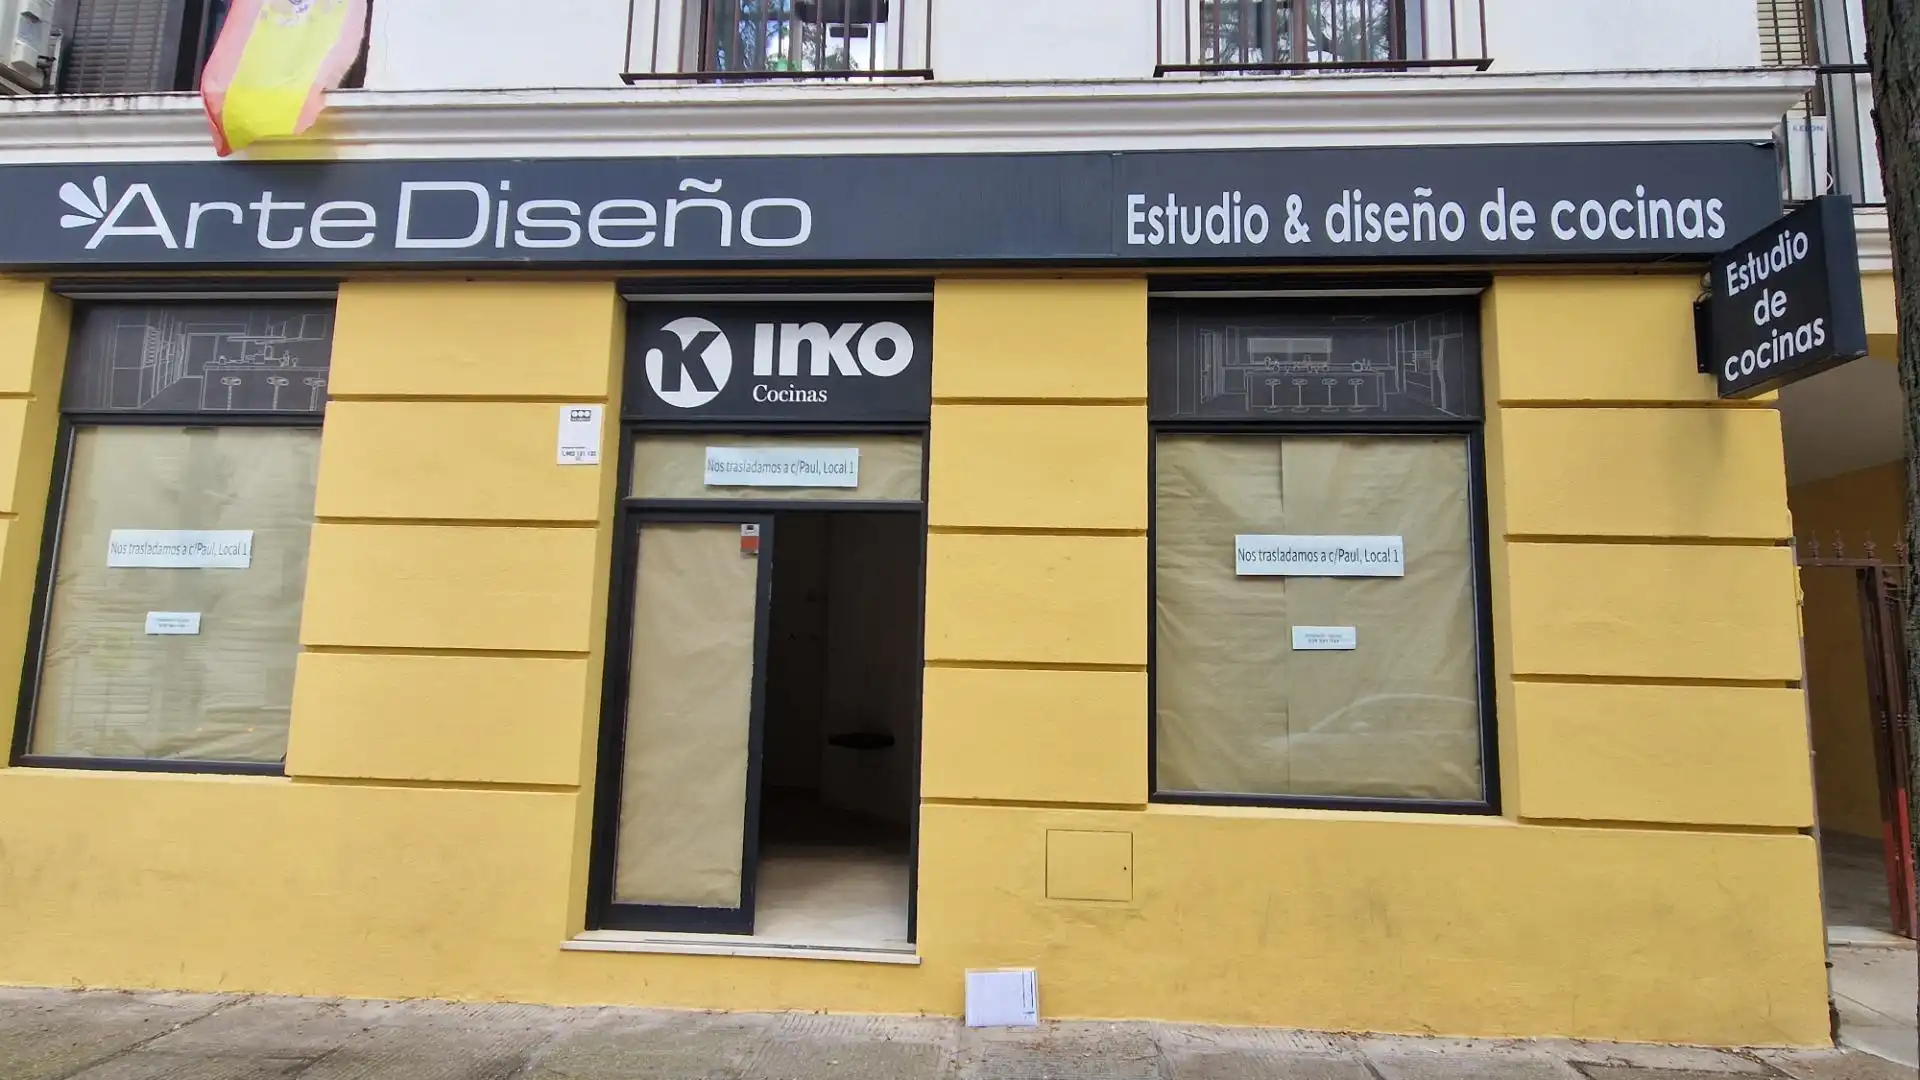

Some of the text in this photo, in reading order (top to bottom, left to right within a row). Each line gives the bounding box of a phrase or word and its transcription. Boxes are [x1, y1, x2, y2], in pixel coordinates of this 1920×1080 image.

[84, 177, 813, 250] Arte Diseño
[1126, 184, 1726, 245] Estudio & diseño de cocinas
[1726, 229, 1809, 297] Estudio
[1753, 287, 1788, 326] de
[1724, 317, 1826, 382] cocinas
[752, 384, 828, 403] Cocinas
[707, 458, 855, 477] Nos trasladamos a c/Paul, Local 1
[111, 542, 126, 555] Nos
[129, 541, 180, 556] trasladamos
[218, 543, 242, 556] Local
[242, 545, 248, 556] 1
[1238, 547, 1399, 565] Nos trasladamos a c/Paul, Local 1
